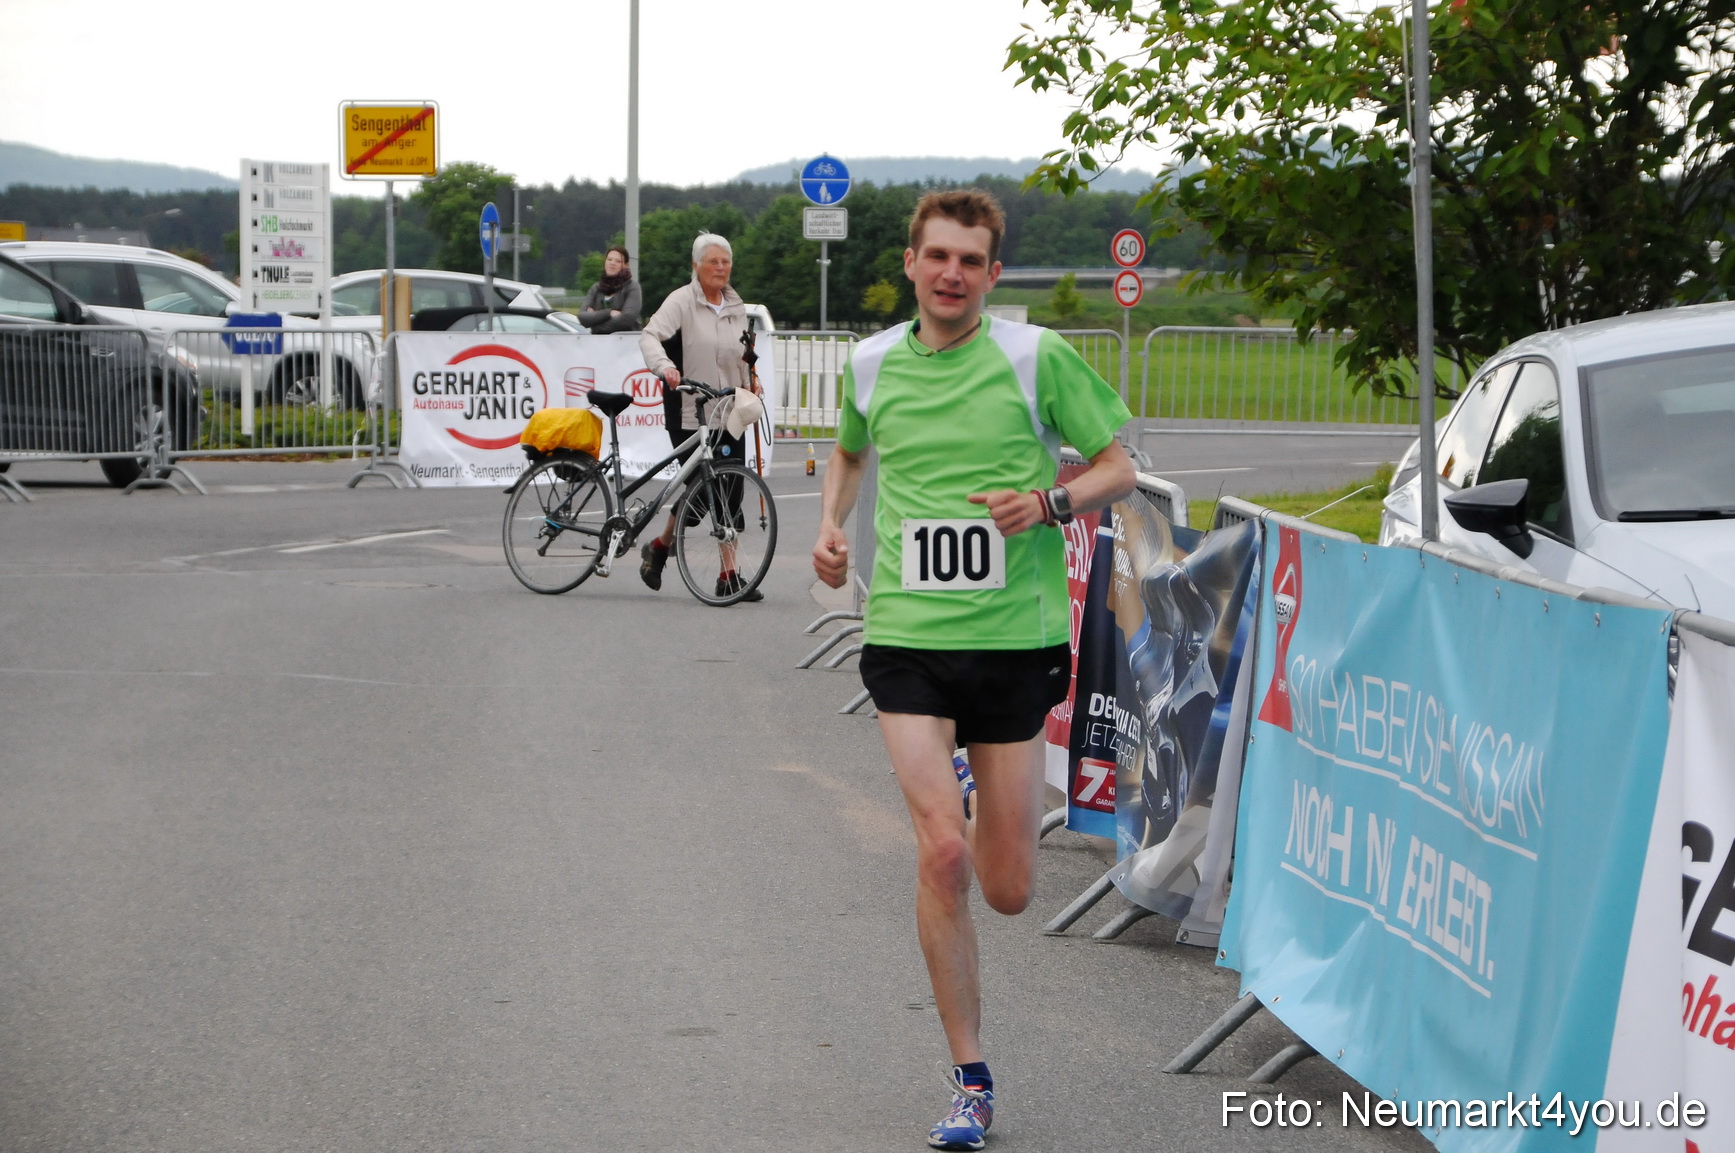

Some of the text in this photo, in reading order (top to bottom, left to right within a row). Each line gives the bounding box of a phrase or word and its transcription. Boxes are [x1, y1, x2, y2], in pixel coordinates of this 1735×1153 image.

[351, 114, 427, 136] Sengenthal
[361, 137, 416, 150] am Anger
[369, 157, 403, 166] Neumarkt
[261, 215, 279, 233] SHB
[1120, 240, 1137, 257] 60
[261, 265, 290, 283] THULE
[413, 371, 531, 395] GERHART &
[413, 398, 464, 410] Autohaus
[463, 396, 535, 420] JÄNIG
[635, 414, 666, 426] MOTO
[410, 463, 465, 479] Neumarkt
[470, 463, 525, 481] Sengenthal
[914, 525, 991, 582] 100
[1076, 763, 1110, 803] 7
[1284, 780, 1354, 887] NOCH
[1397, 835, 1495, 981] ERLEBT.
